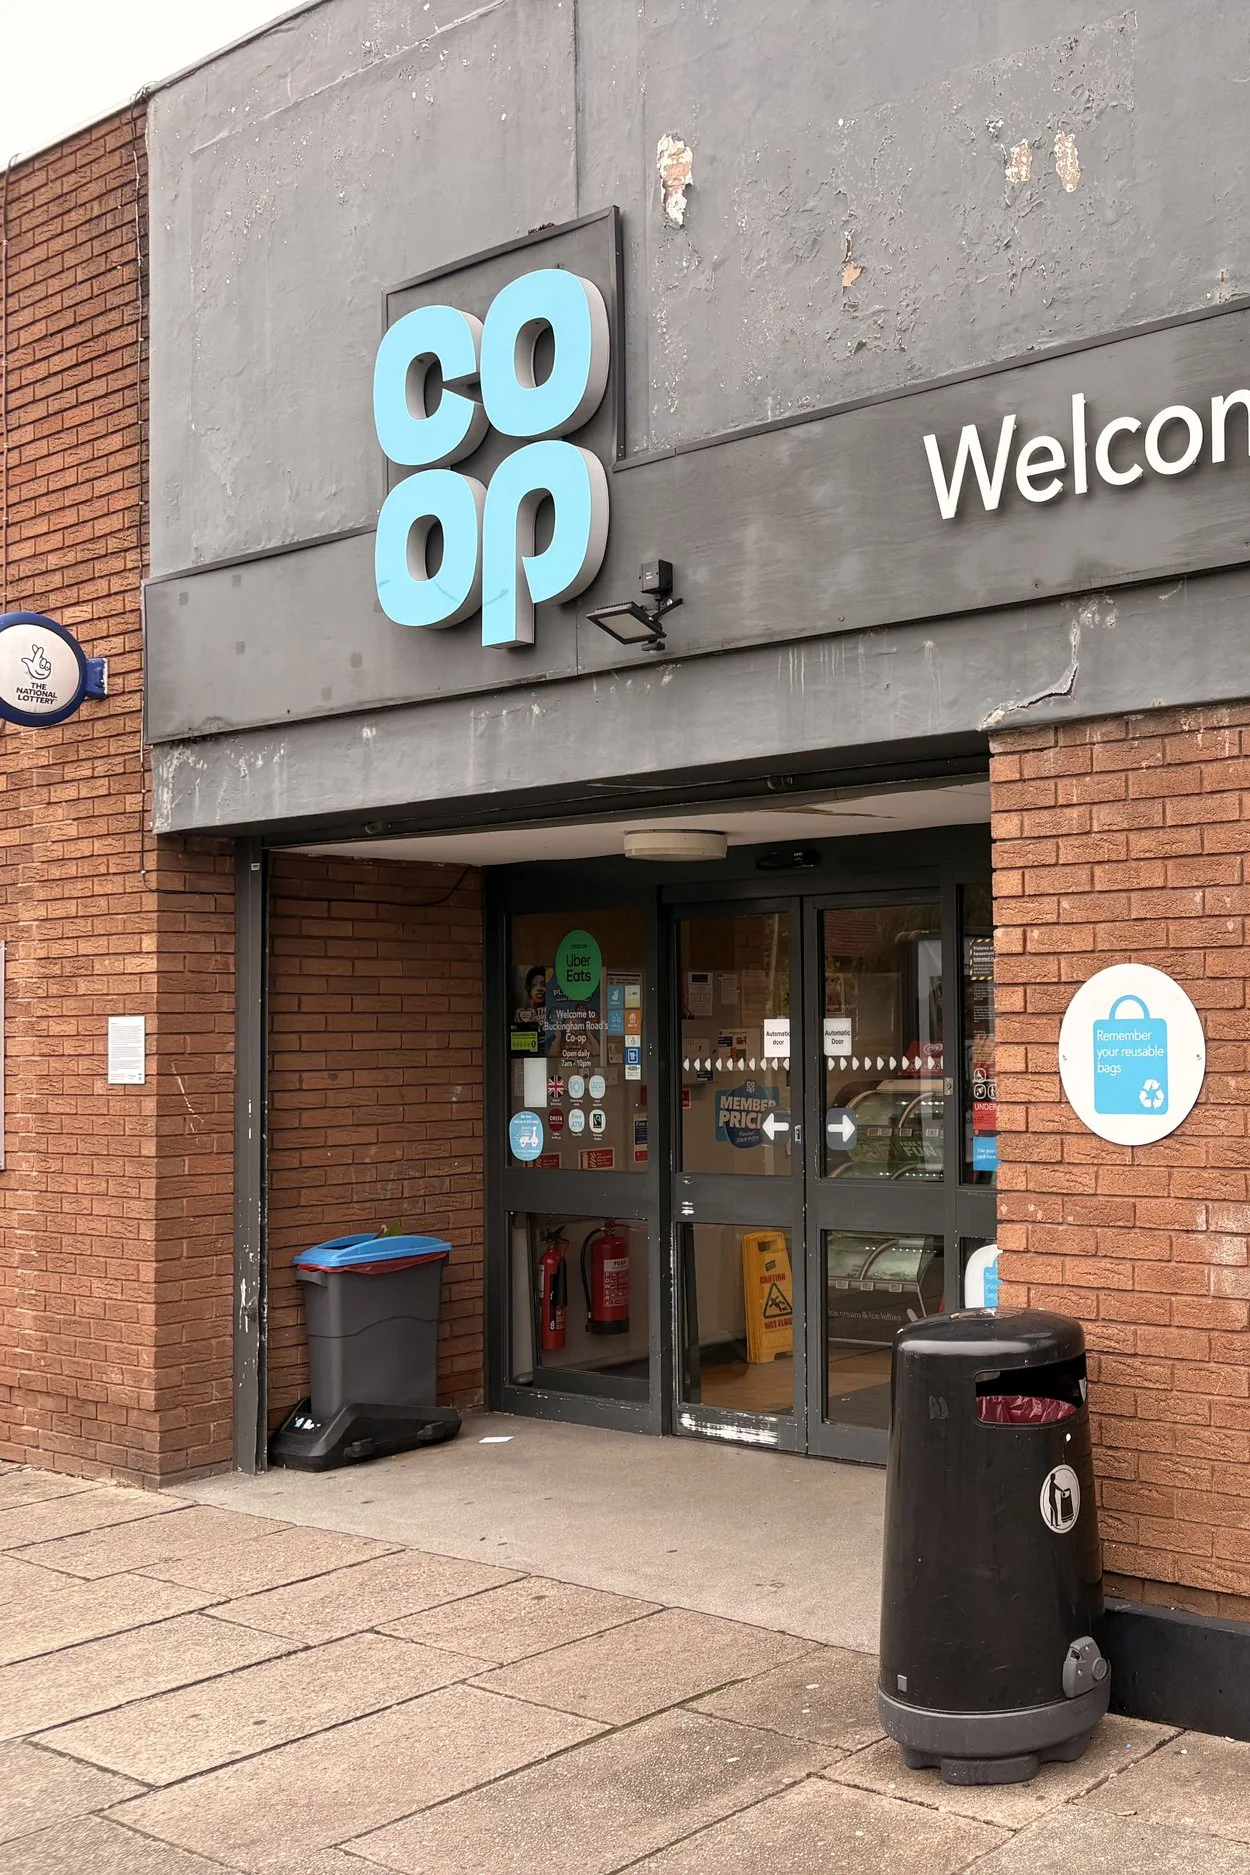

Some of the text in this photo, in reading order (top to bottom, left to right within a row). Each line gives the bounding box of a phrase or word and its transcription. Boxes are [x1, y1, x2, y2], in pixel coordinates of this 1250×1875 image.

[30, 682, 47, 691] THE
[16, 686, 58, 699] NATIONAL
[17, 694, 56, 705] LOTTERY
[566, 954, 592, 967] Uber
[566, 969, 592, 983] Eats
[556, 1009, 596, 1019] Welcome to
[544, 1021, 608, 1032] Buckingham Road's
[565, 1033, 587, 1044] Co-op
[824, 1029, 851, 1037] Automatic
[1096, 1029, 1152, 1041] Remember
[562, 1049, 590, 1058] Open daily
[1096, 1044, 1164, 1060] your reusable
[1097, 1061, 1122, 1076] bags
[760, 1273, 786, 1284] CAUTION
